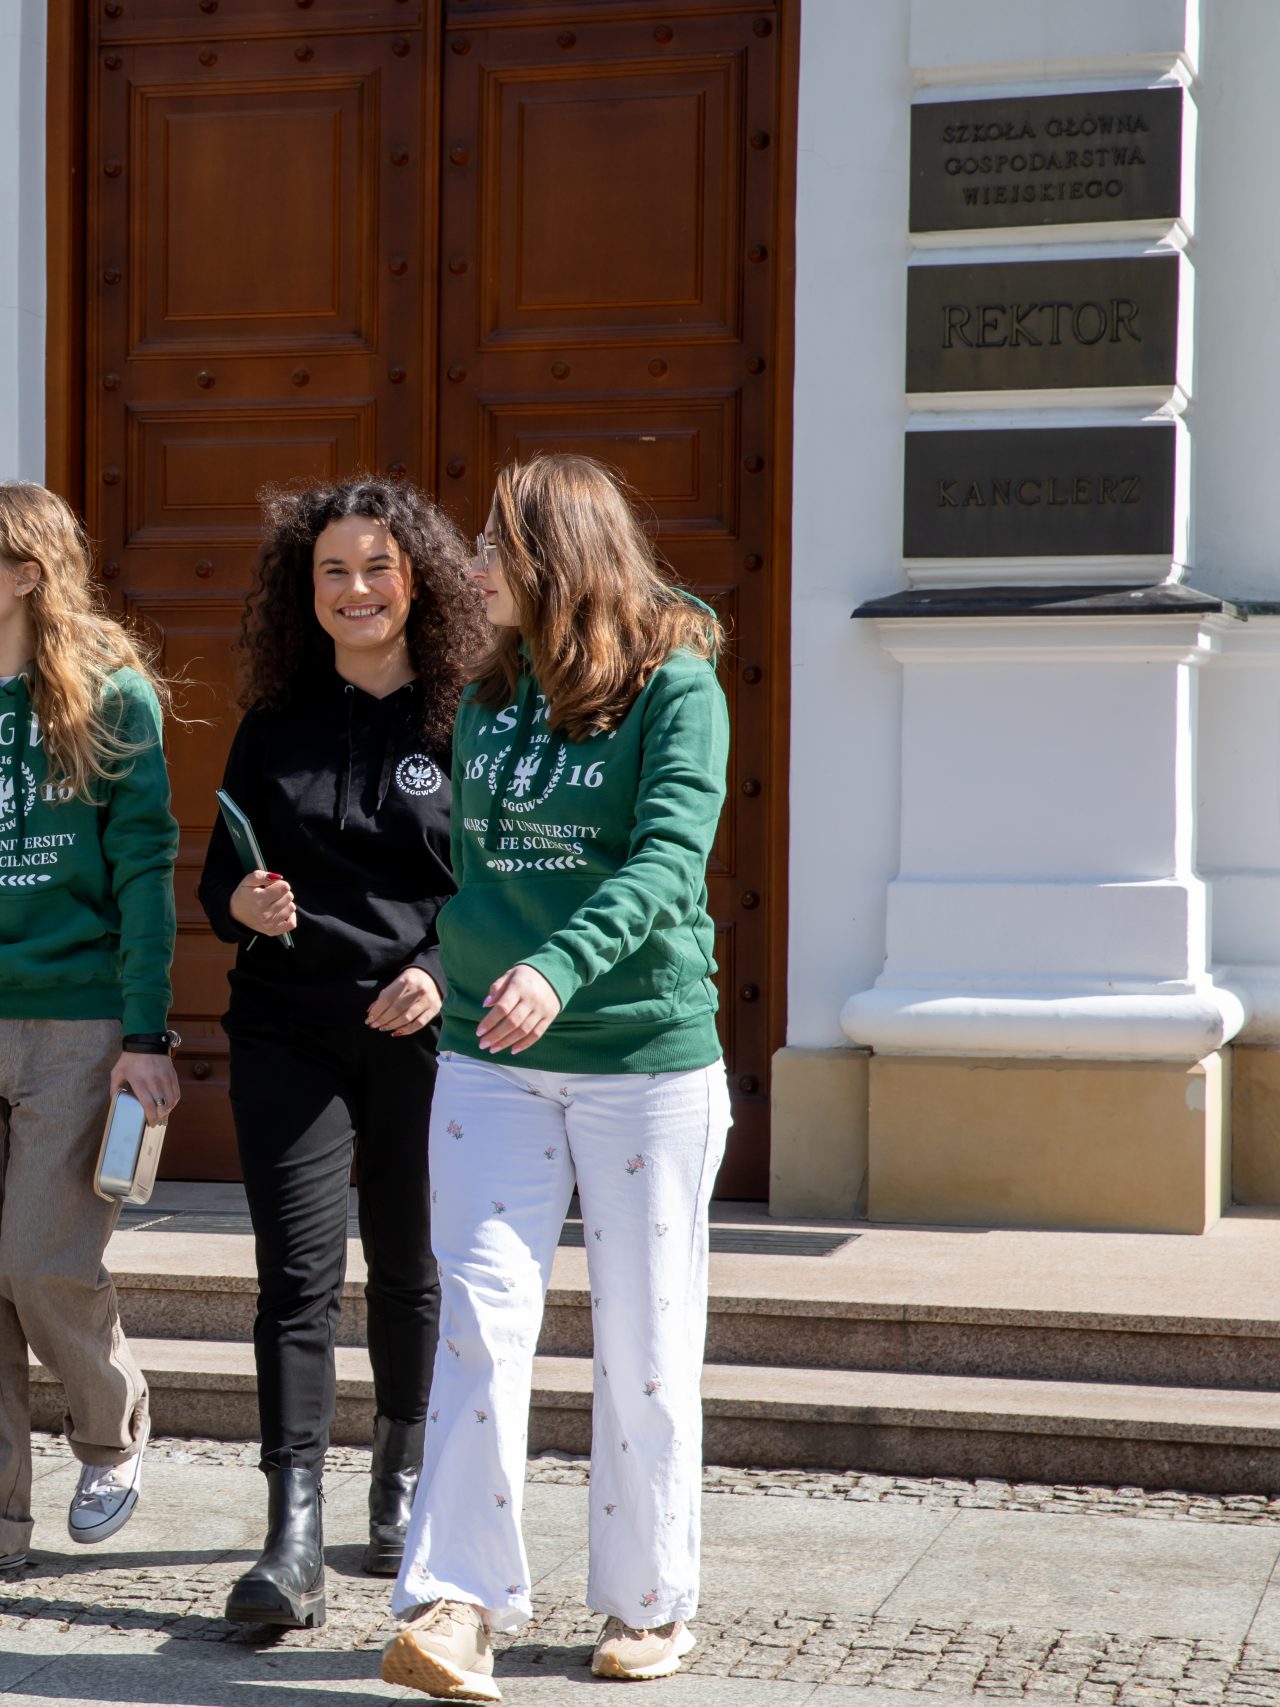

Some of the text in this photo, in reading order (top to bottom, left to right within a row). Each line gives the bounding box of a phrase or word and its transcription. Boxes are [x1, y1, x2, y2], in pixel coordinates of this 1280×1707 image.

[942, 112, 1149, 145] SZKOŁA GŁÓWNA
[945, 147, 1146, 176] GOSPODARSTWA
[962, 179, 1123, 206] WIEJSKIEGO
[942, 298, 1142, 349] REKTOR
[937, 475, 1142, 508] KANCLERZ
[566, 761, 606, 788] 16
[501, 798, 536, 813] SGGW
[464, 817, 601, 839] WARSW UNIVERSITY
